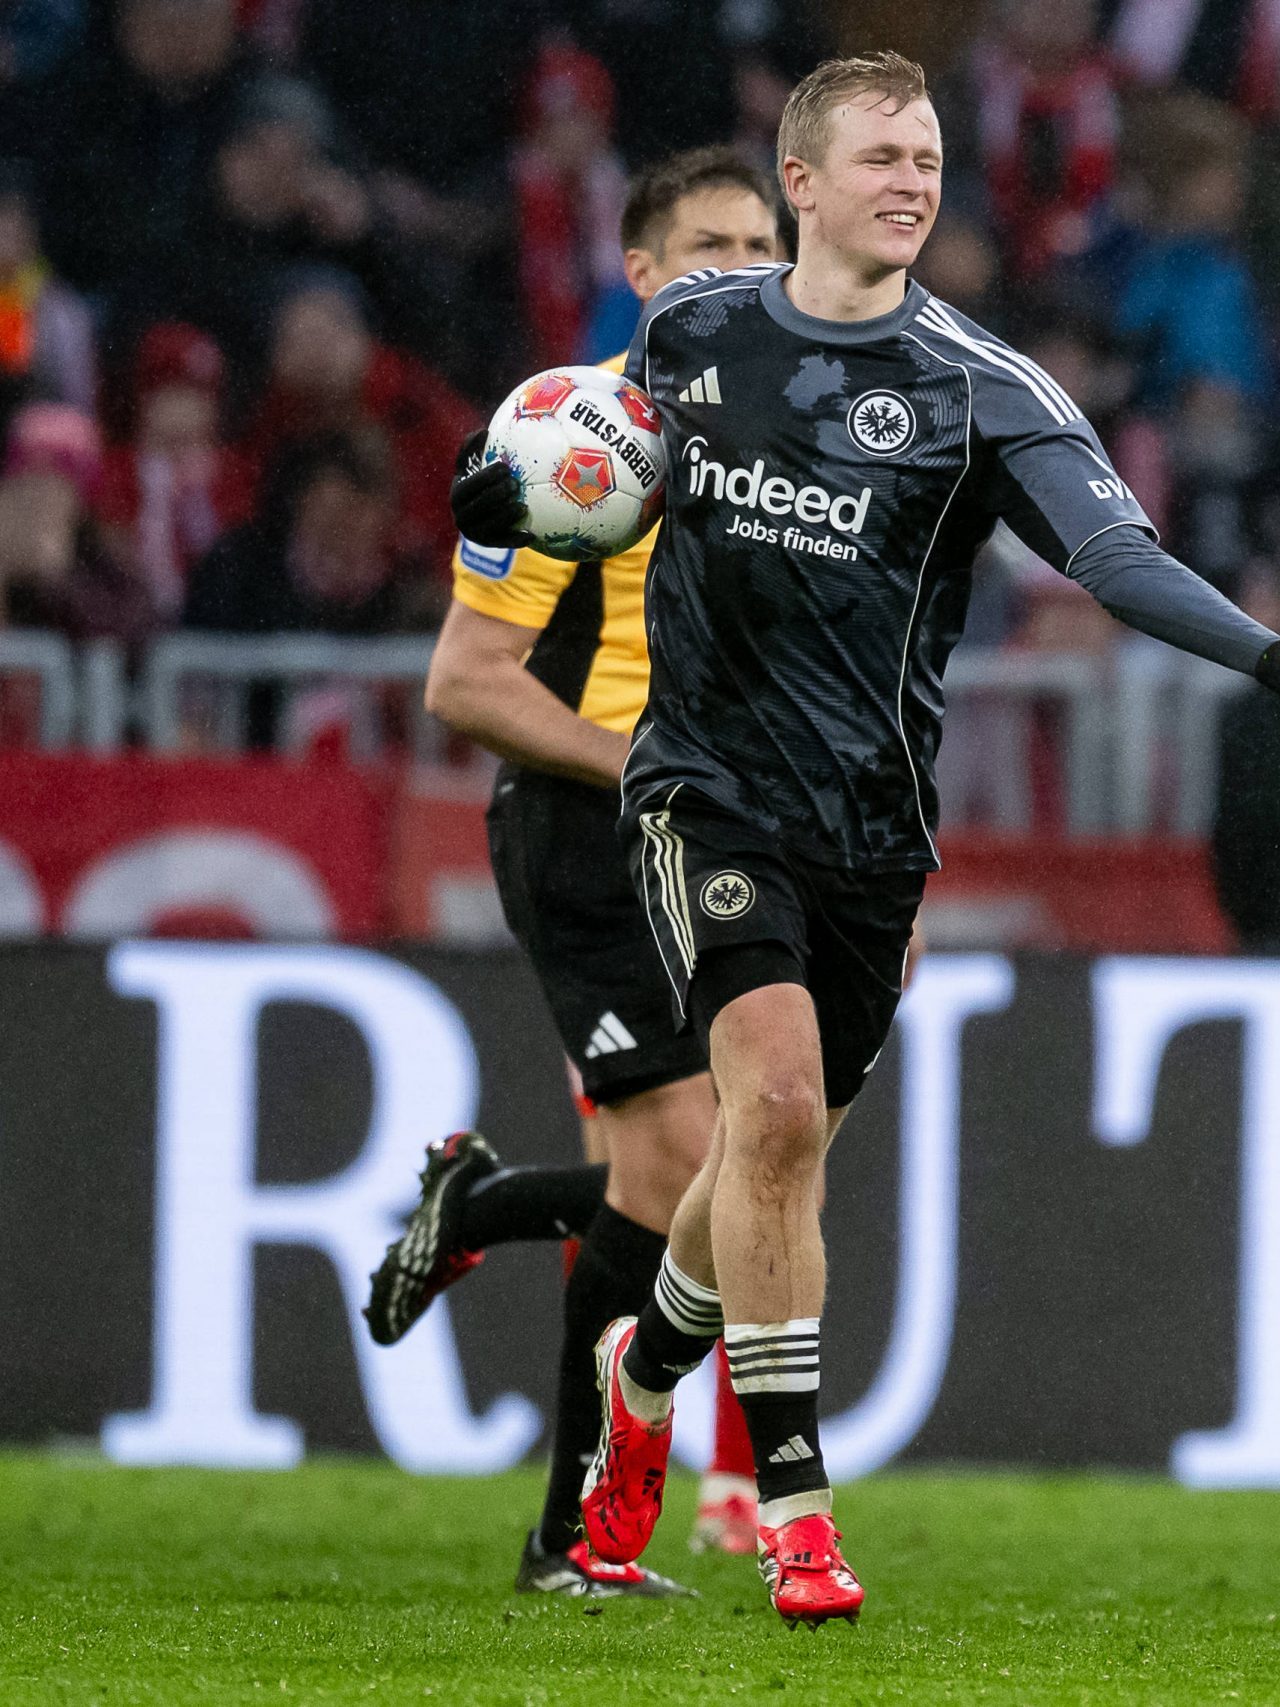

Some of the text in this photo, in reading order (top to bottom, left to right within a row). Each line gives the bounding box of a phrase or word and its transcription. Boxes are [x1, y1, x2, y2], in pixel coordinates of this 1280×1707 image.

[569, 402, 657, 490] DERBYSTAR
[682, 435, 872, 535] indeed
[726, 514, 858, 562] Jobs finden
